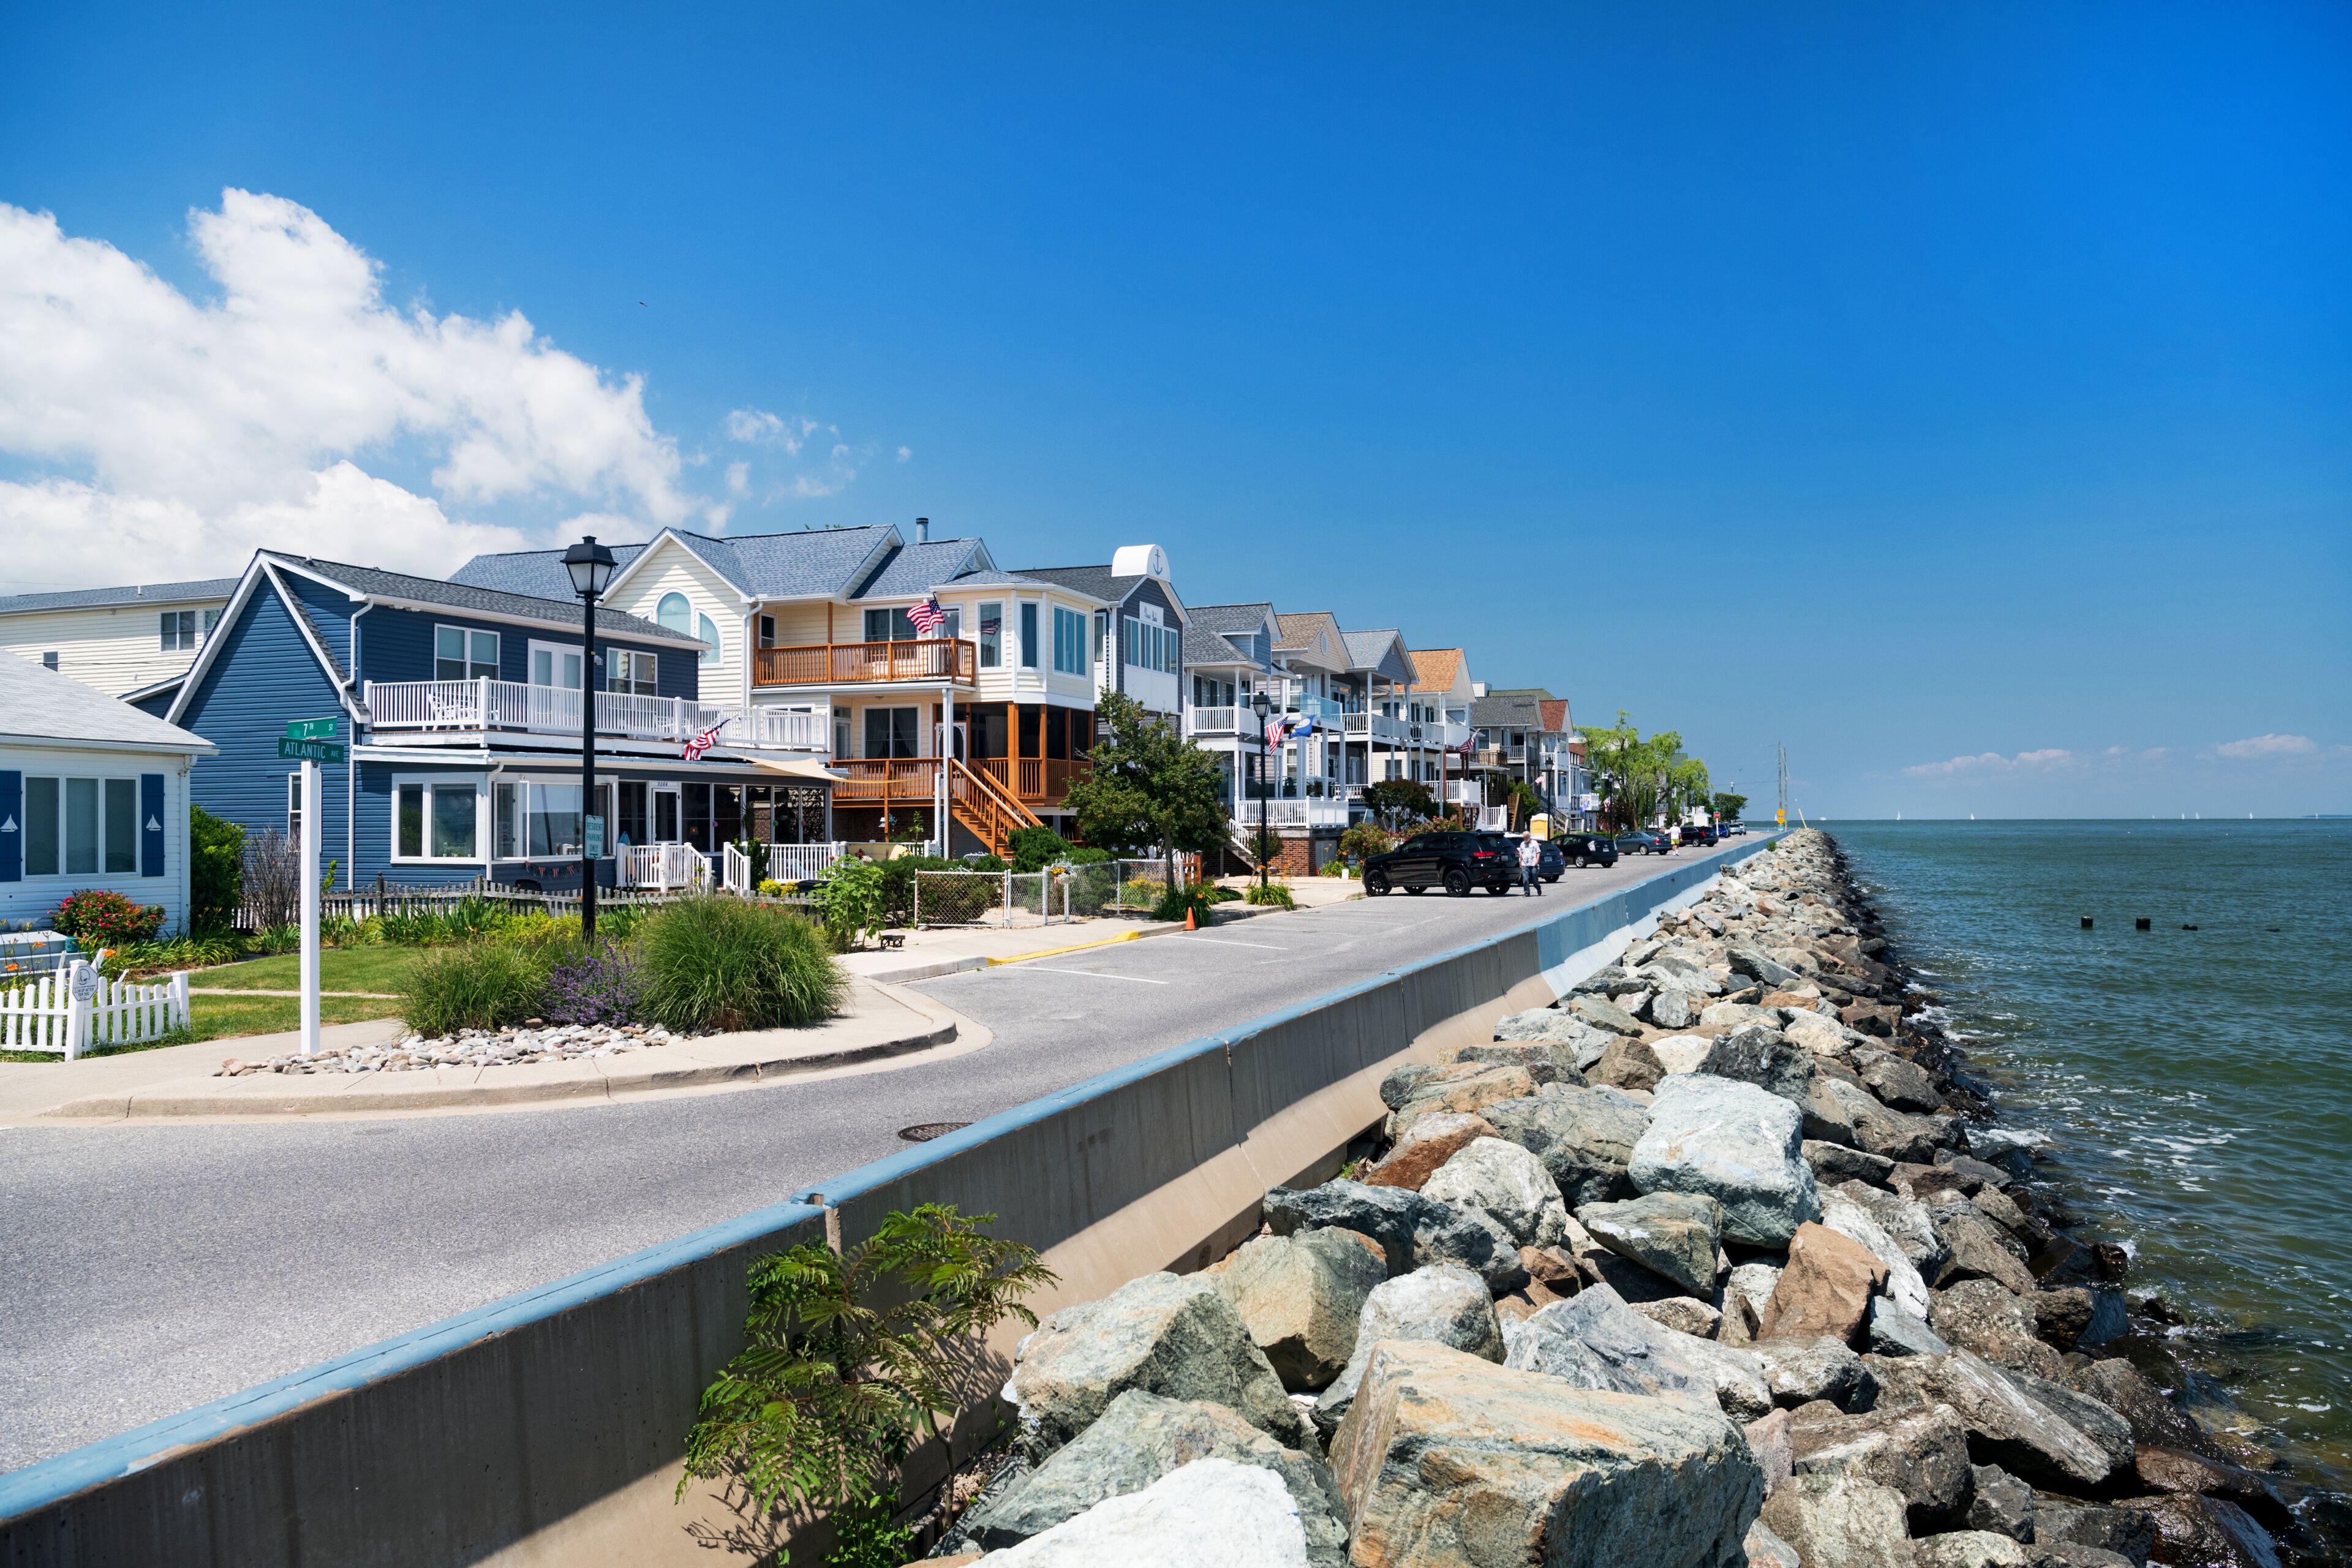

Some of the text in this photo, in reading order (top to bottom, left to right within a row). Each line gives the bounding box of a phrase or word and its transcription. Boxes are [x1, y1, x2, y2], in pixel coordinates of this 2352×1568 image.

[284, 742, 325, 759] ATLANTIC
[587, 833, 602, 842] PARKING
[590, 843, 598, 853] ONLY
